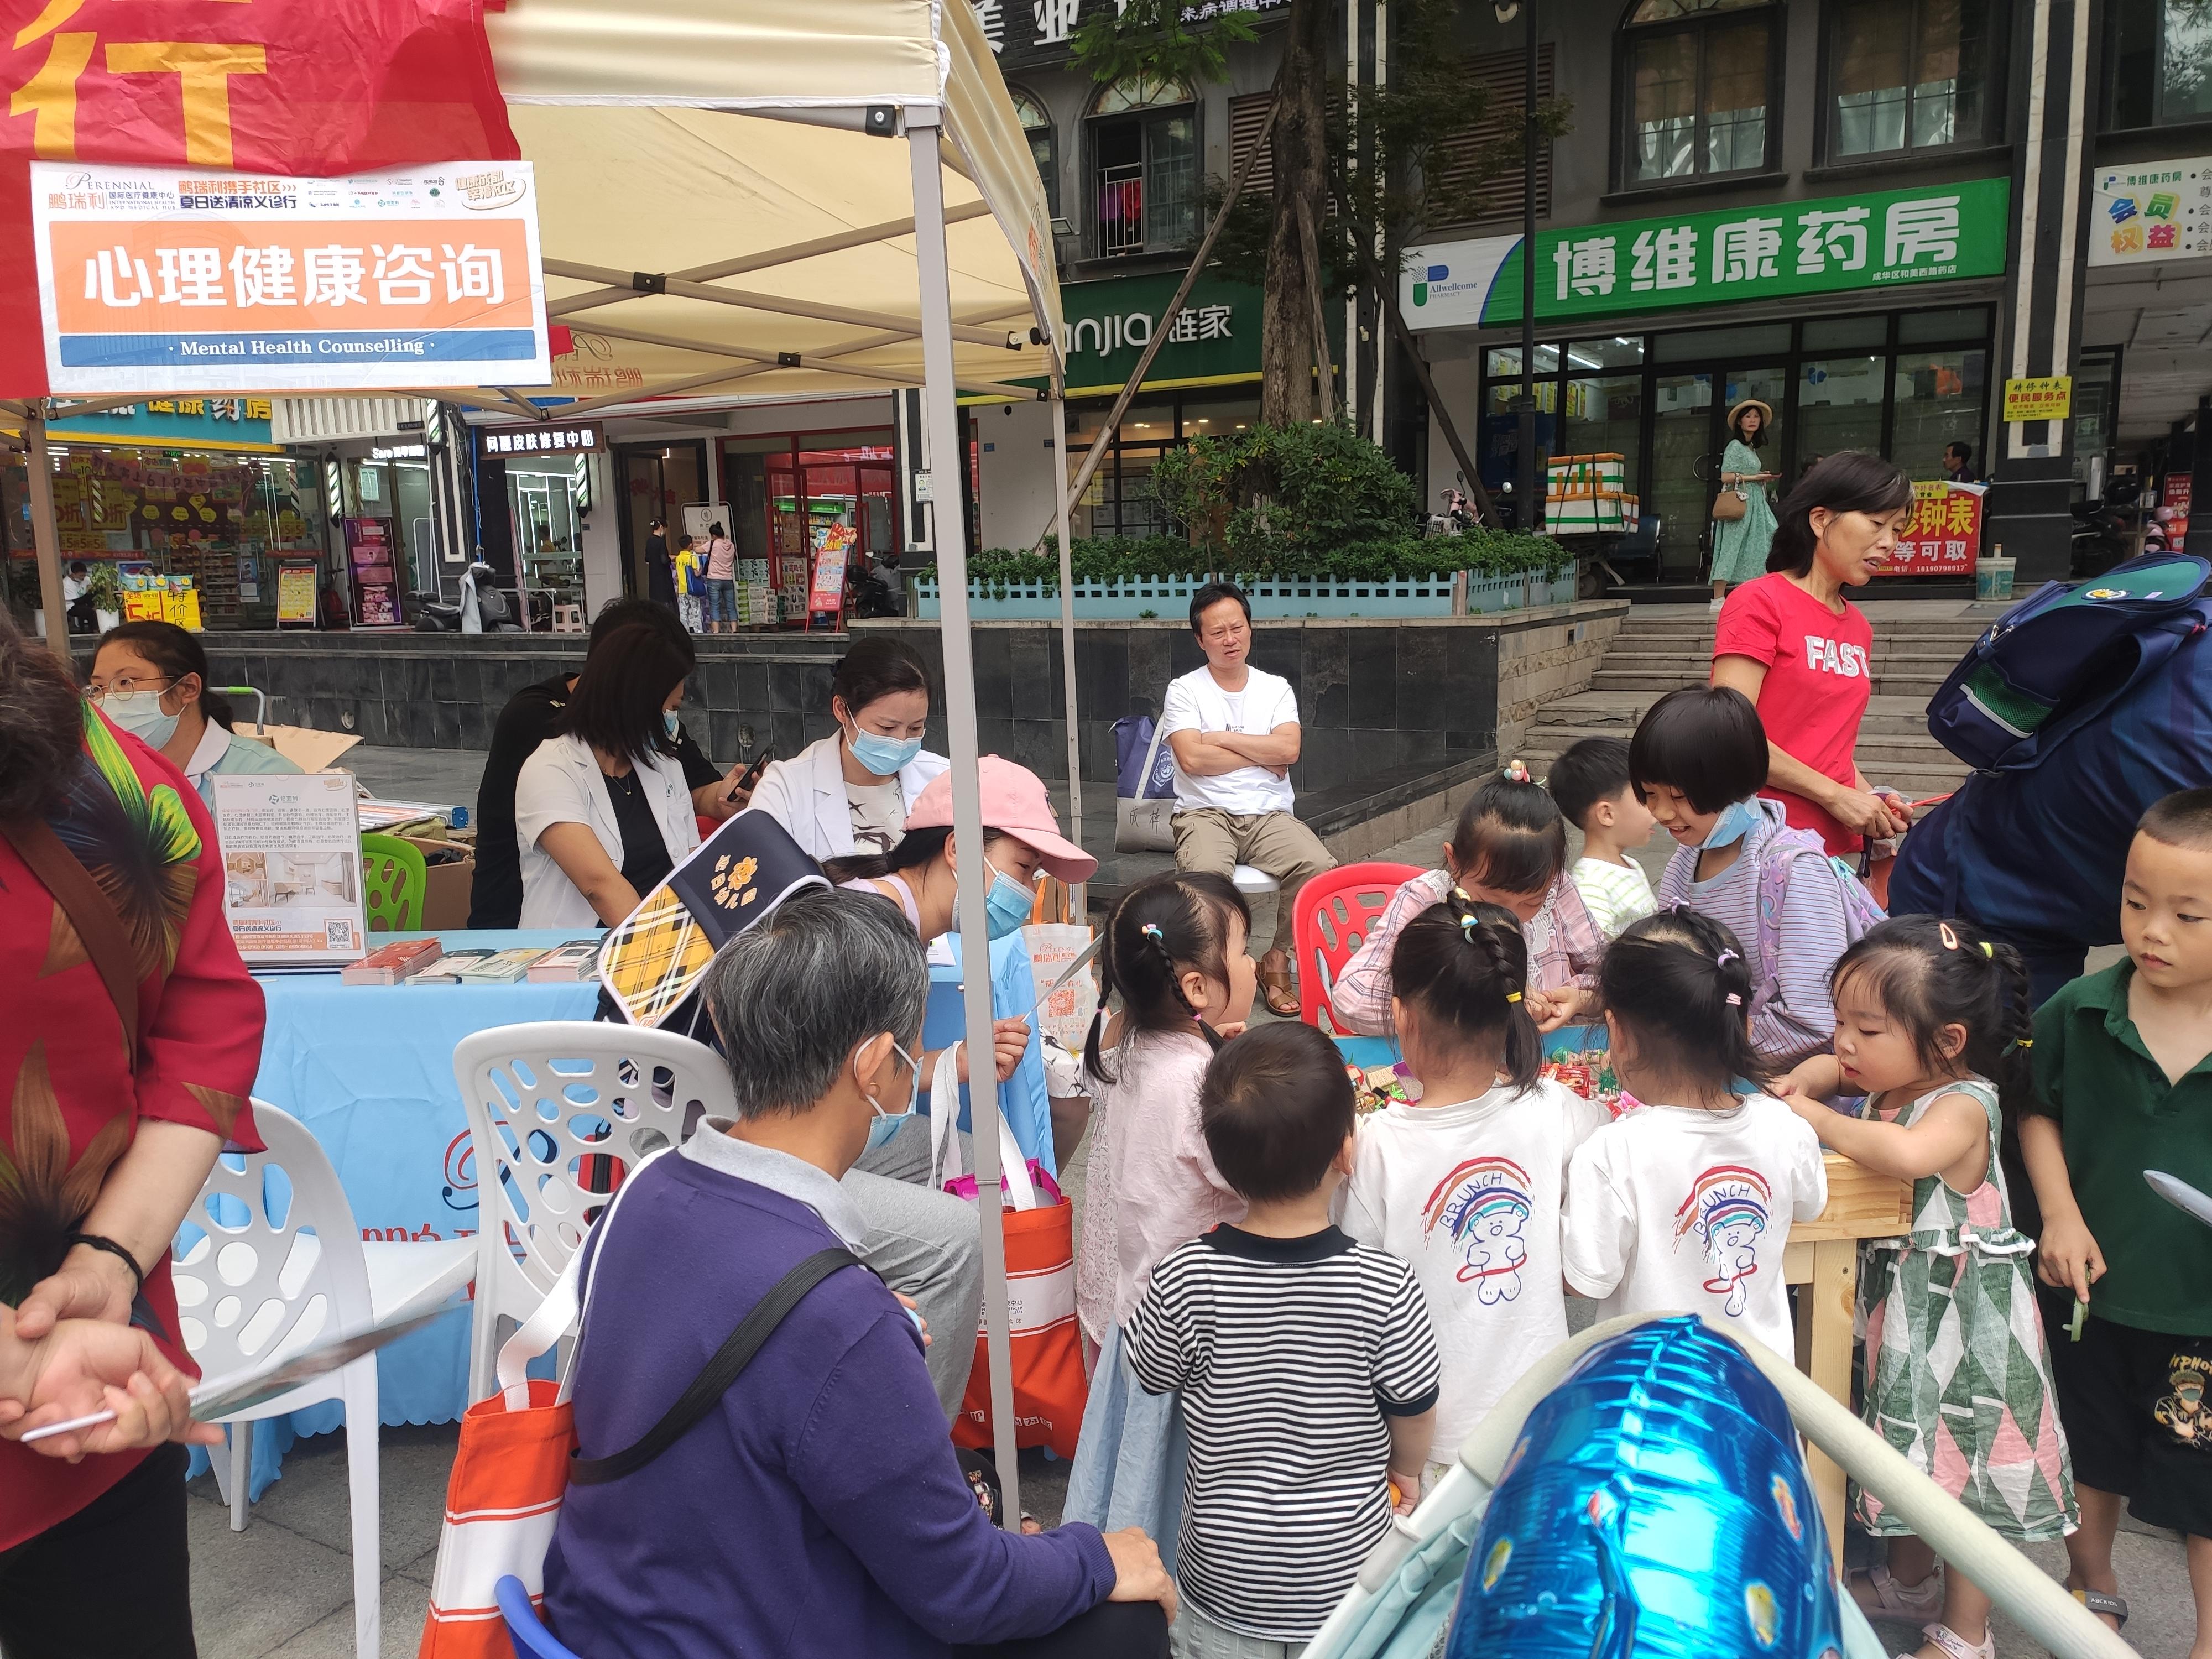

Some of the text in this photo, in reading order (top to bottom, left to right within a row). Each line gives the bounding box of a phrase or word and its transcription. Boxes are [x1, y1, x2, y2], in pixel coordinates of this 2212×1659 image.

[65, 172, 155, 190] PERENNIAL
[2127, 171, 2182, 186] 博维康药房
[179, 181, 281, 194] 鹏瑞利携手社区
[48, 192, 105, 210] 鹏瑞利
[180, 195, 297, 209] 夏日送清凉义诊行
[2108, 194, 2174, 224] 会员
[2198, 221, 2212, 233] 会
[2111, 224, 2176, 254] 权益
[1553, 195, 1960, 301] 博维康药房
[84, 244, 505, 308] 心理健康咨询
[1872, 265, 1957, 281] 成华区和美西路药店
[1430, 281, 1478, 294] Allwellcome
[1430, 291, 1460, 299] PHARMACY
[180, 337, 425, 357] Mental Health Counselling
[2013, 380, 2063, 393] 精修钟表
[2009, 392, 2067, 403] 便民服务点
[486, 429, 594, 453] 问题皮肤修复中心
[1916, 564, 1965, 572] 18190798917
[1805, 635, 1870, 678] FAST
[1033, 952, 1061, 963] 鹏瑞利
[1439, 1172, 1503, 1229] BRUNCH
